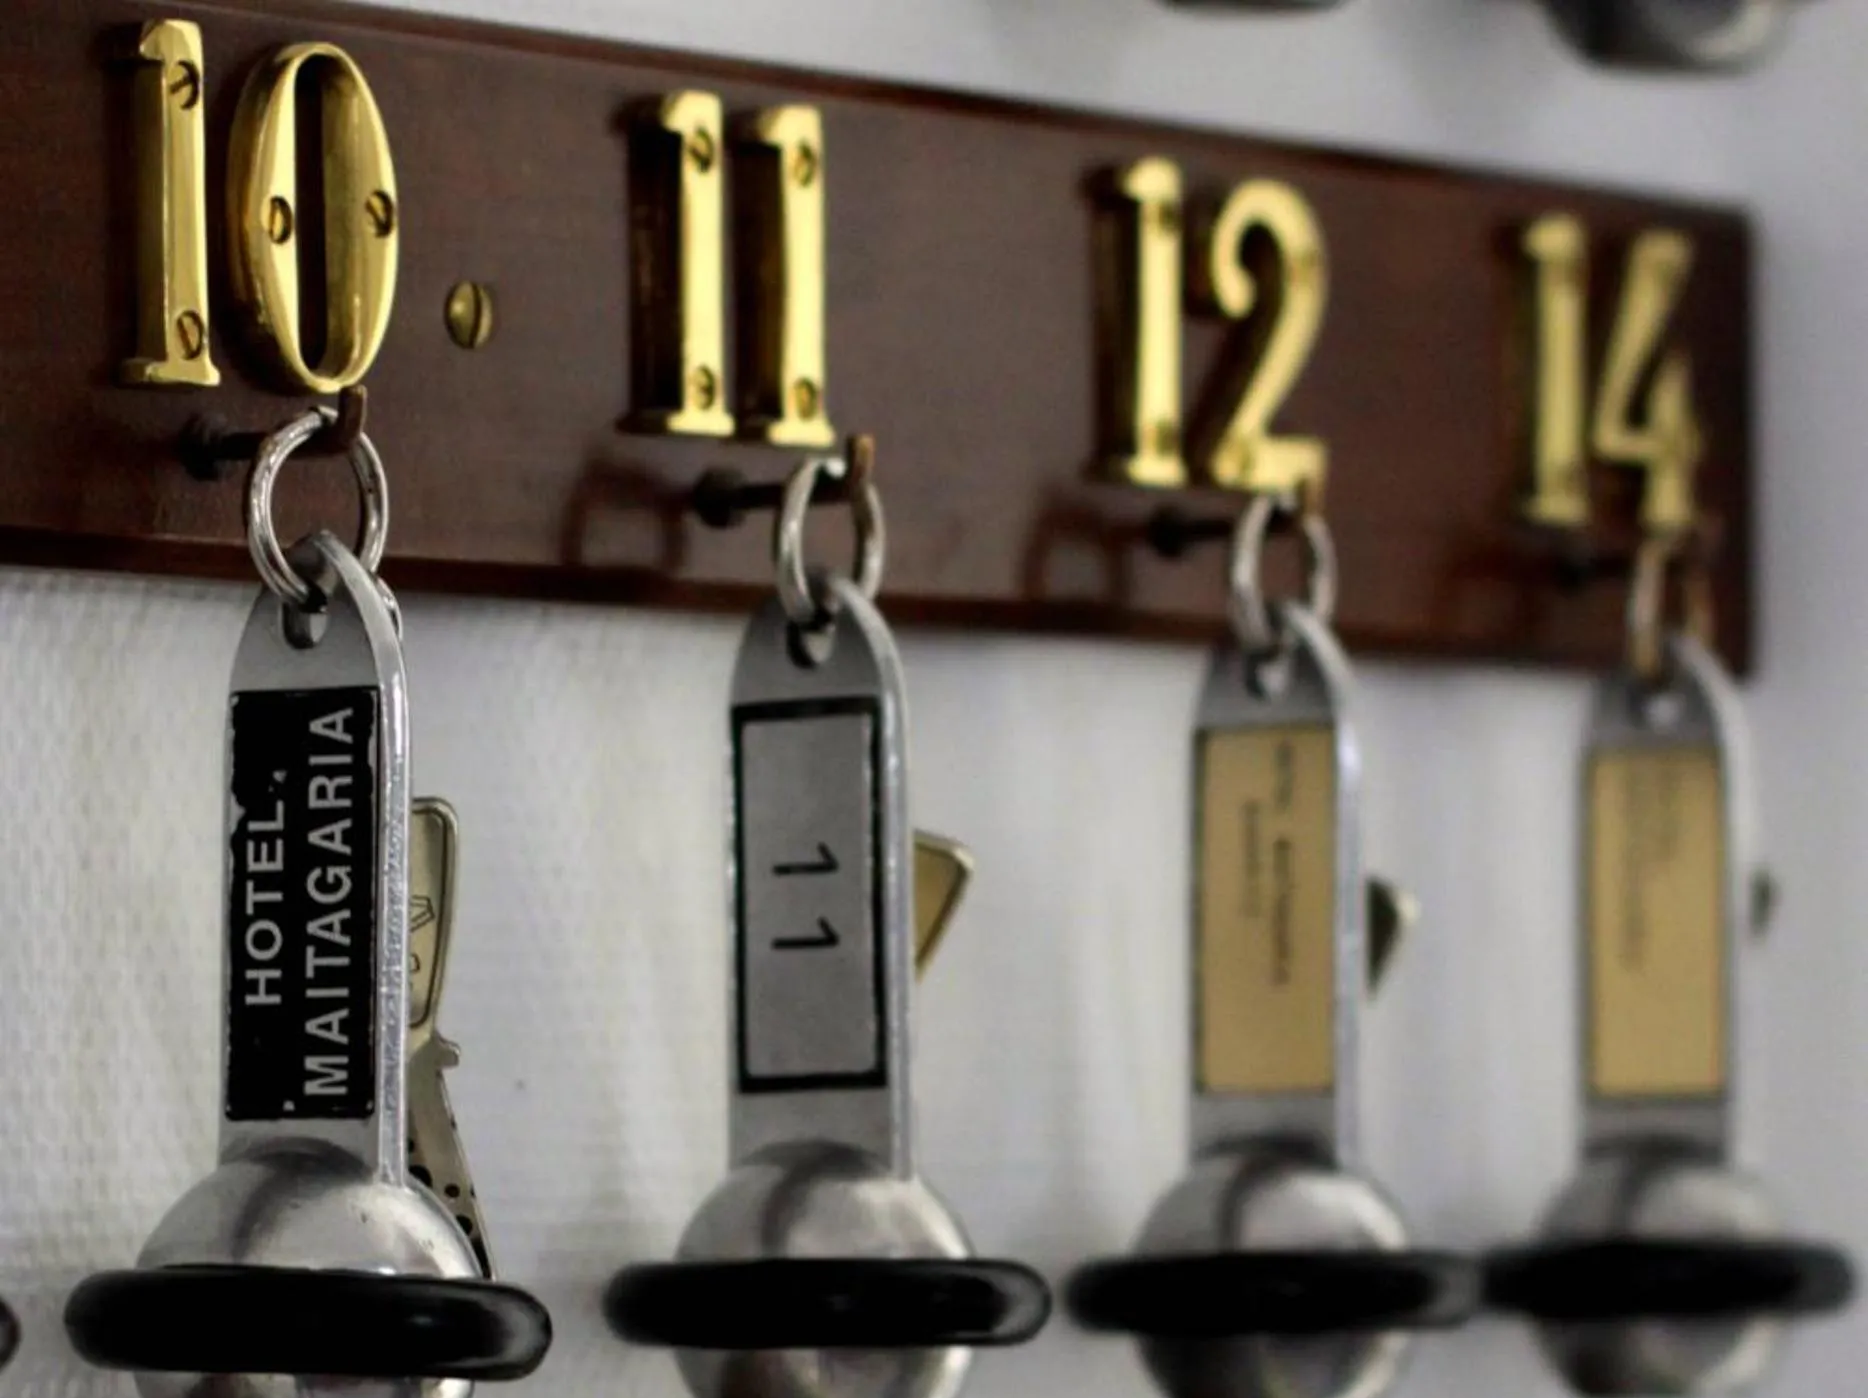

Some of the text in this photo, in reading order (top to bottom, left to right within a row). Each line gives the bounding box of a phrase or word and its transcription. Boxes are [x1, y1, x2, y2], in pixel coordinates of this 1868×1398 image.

[122, 17, 398, 394] 10
[655, 88, 836, 447] 11
[1124, 155, 1328, 492] 12
[1524, 210, 1703, 530] 14
[245, 799, 285, 1006] HOTEL
[304, 706, 354, 1096] MAITAGARIA
[771, 841, 840, 951] 11
